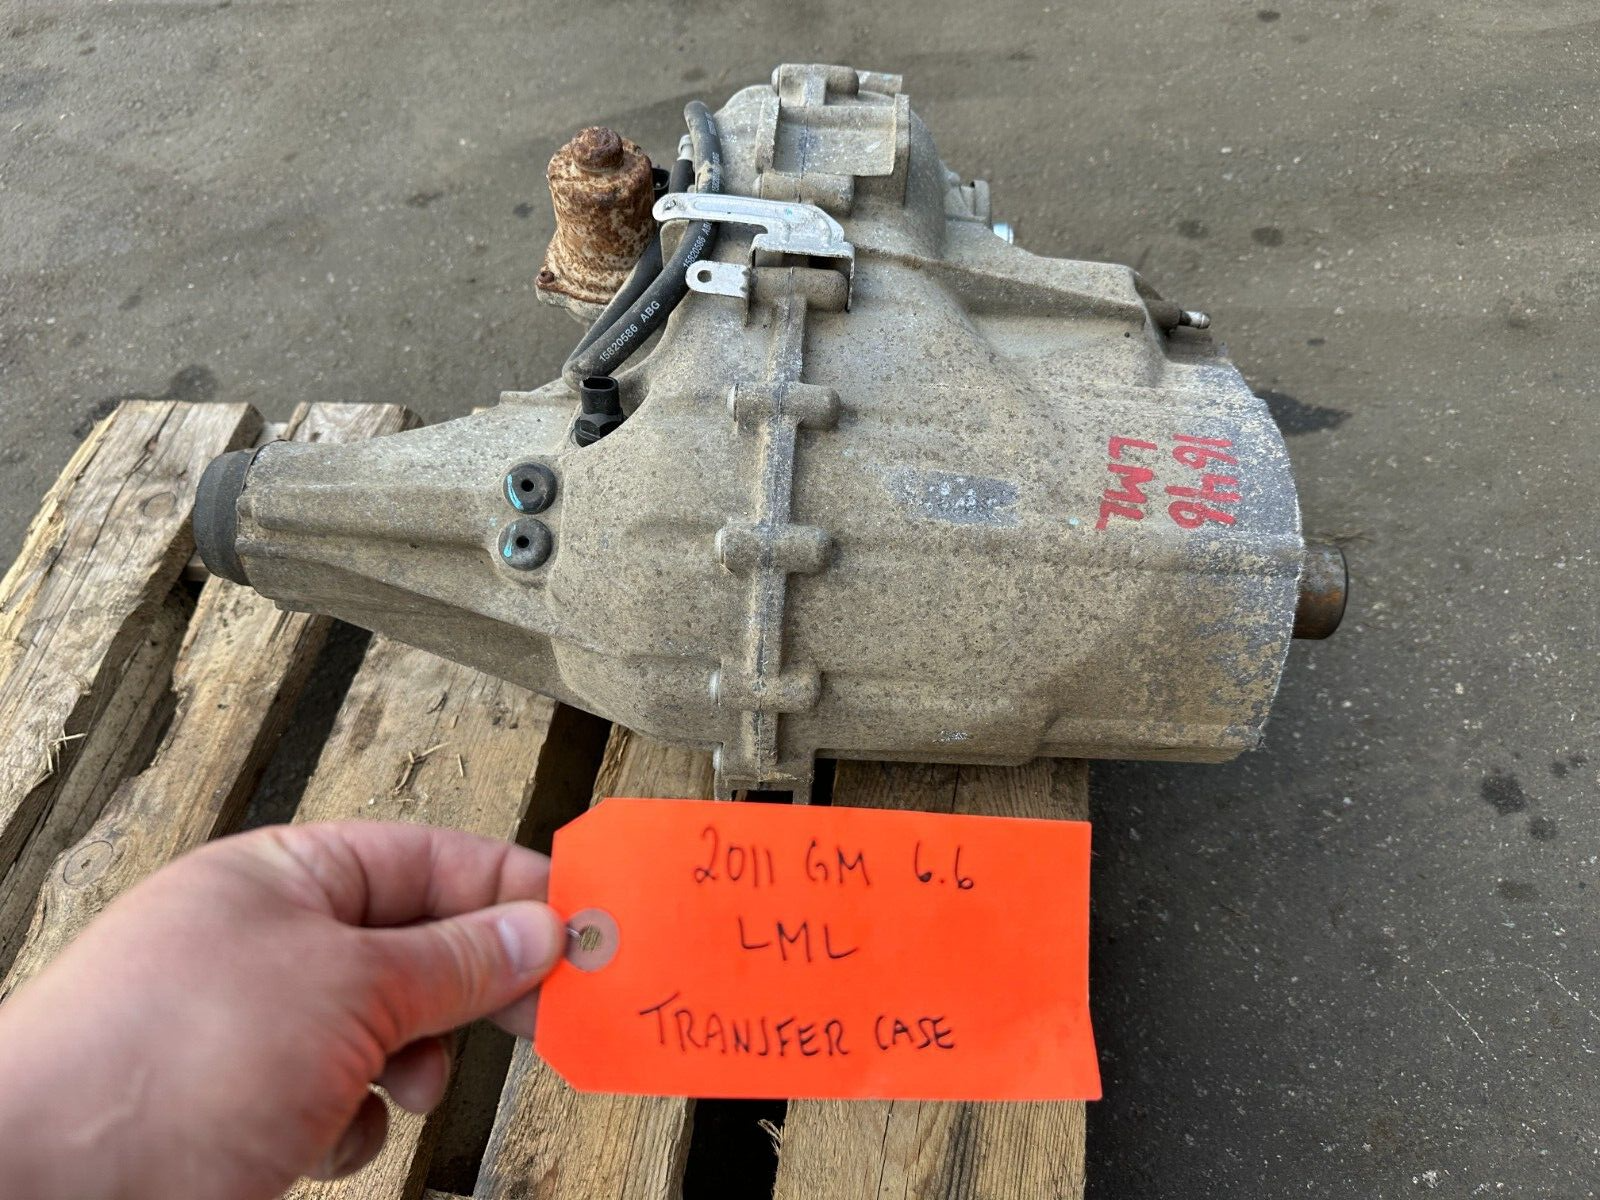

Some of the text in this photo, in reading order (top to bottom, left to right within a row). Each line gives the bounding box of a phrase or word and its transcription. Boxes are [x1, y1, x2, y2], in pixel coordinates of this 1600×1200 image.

[600, 300, 661, 362] 15820586 ABG
[1095, 435, 1158, 531] LML
[1165, 434, 1242, 529] 1646
[694, 826, 974, 890] 2011 GM 6.6
[738, 917, 858, 962] LML
[639, 991, 955, 1058] TRANSFER CASE
